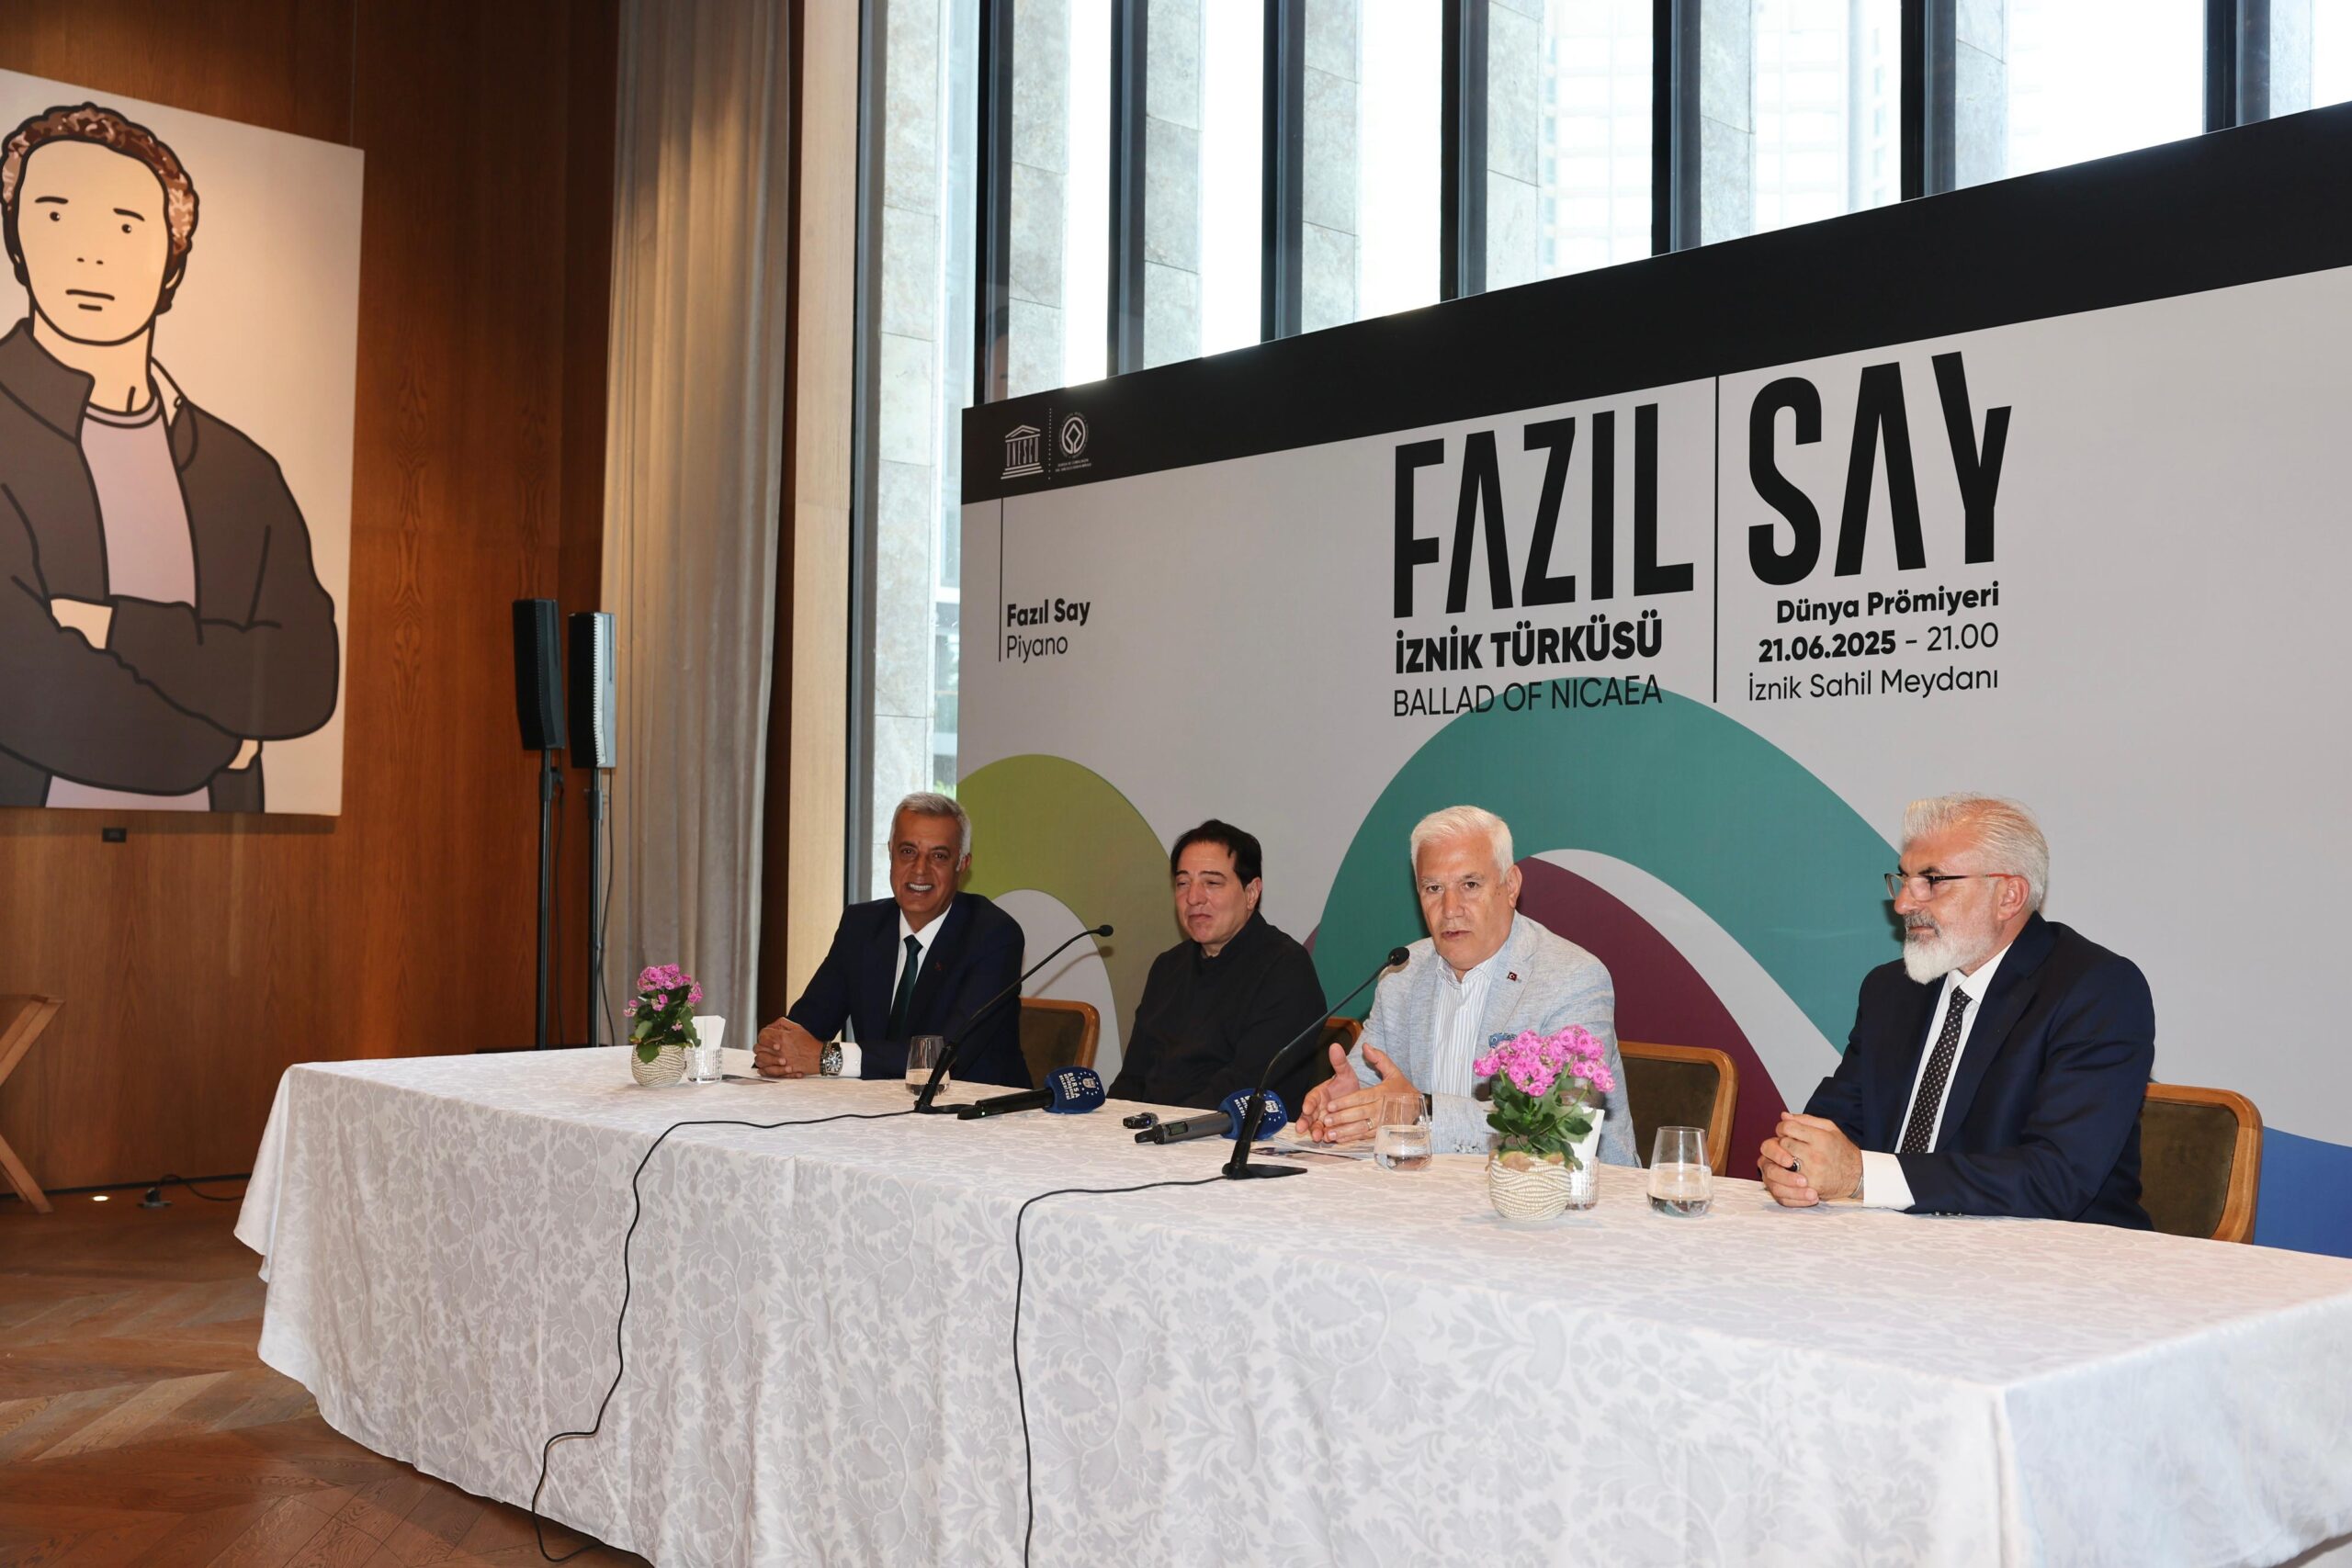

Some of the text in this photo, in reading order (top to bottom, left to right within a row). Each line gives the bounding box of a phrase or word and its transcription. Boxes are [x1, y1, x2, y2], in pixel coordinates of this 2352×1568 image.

[1395, 352, 2011, 618] FAZIL SAY
[1006, 598, 1091, 628] Fazıl Say
[1778, 581, 1999, 626] Dünya Prömiyeri
[1006, 635, 1069, 664] Piyano
[1396, 608, 1662, 674] İZNİK TÜRKÜSÜ
[1758, 629, 1896, 663] 21.06.2025
[1927, 622, 1998, 651] 21.00
[1394, 675, 1663, 717] BALLAD OF NICAEA
[1749, 666, 1998, 701] İznik Sahil Meydanı
[1068, 1073, 1080, 1099] BURSA
